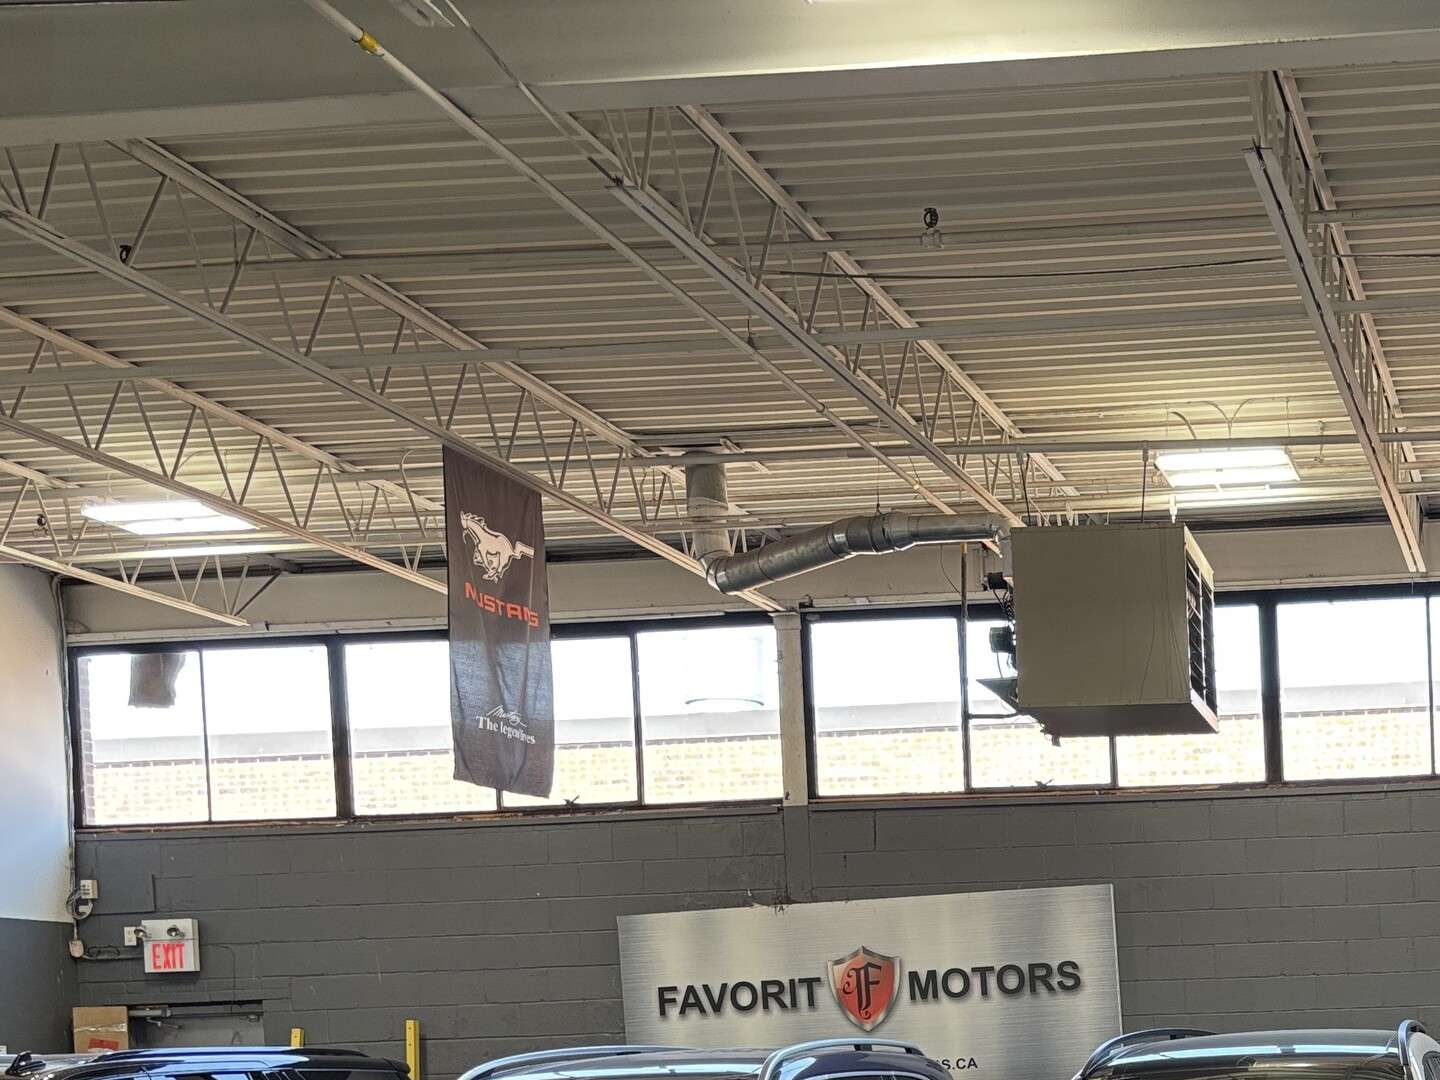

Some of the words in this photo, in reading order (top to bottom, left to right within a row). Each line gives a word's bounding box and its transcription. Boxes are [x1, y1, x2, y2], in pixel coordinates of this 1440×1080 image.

[475, 715, 499, 732] The
[152, 943, 186, 969] EXIT
[657, 976, 822, 1016] FAVORIT
[908, 960, 1081, 1002] MOTORS
[936, 1057, 978, 1070] S.CA
